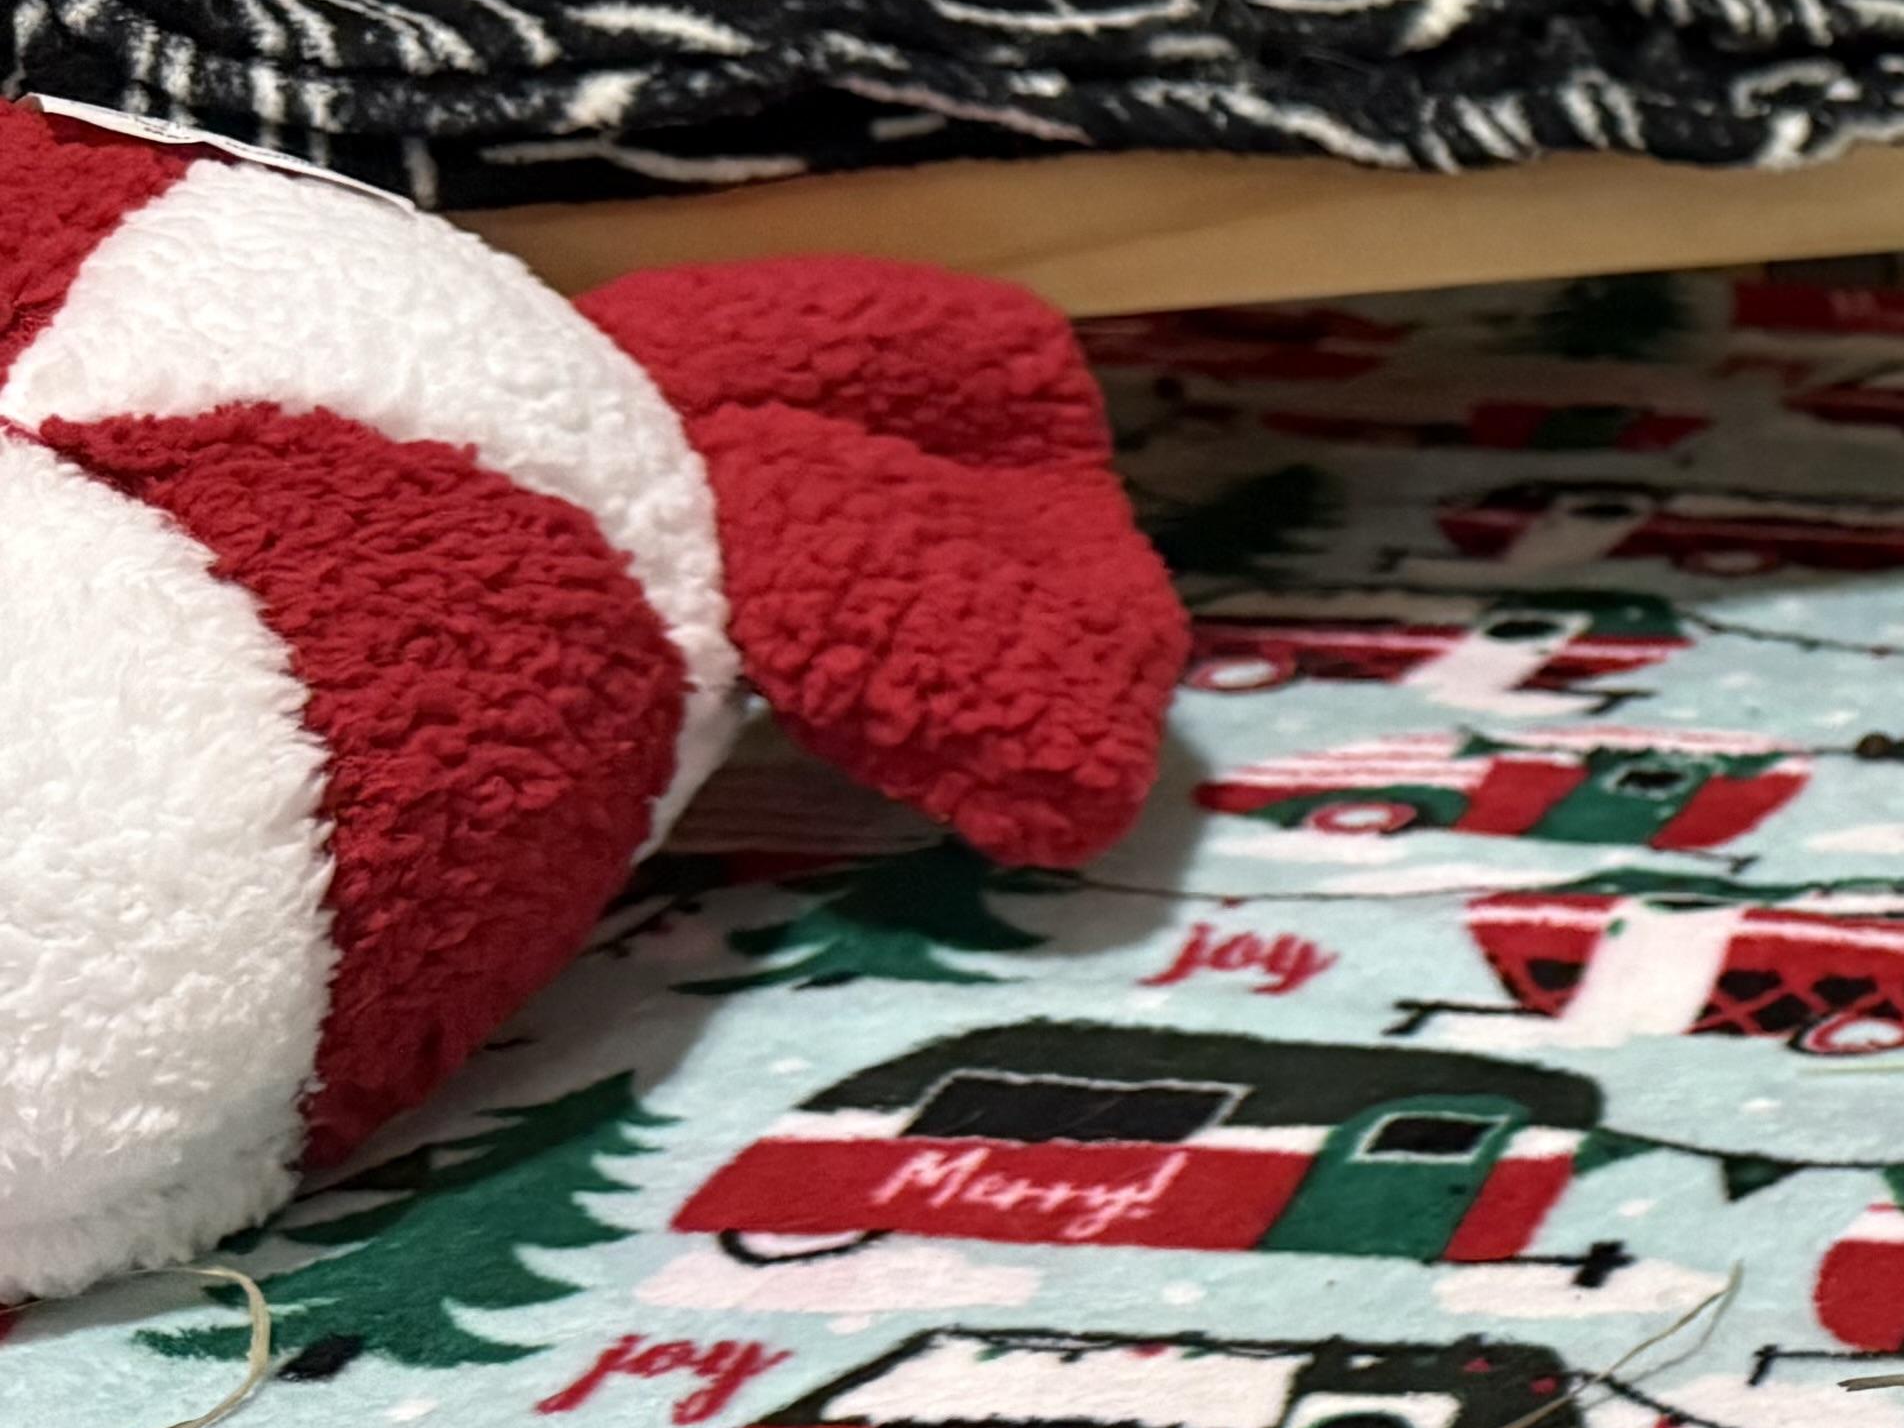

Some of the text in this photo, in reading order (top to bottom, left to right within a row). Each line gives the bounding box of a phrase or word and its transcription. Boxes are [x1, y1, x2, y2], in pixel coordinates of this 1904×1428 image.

[1136, 922, 1340, 996] joy
[870, 1147, 1190, 1239] Merry!
[533, 1334, 794, 1425] joy
